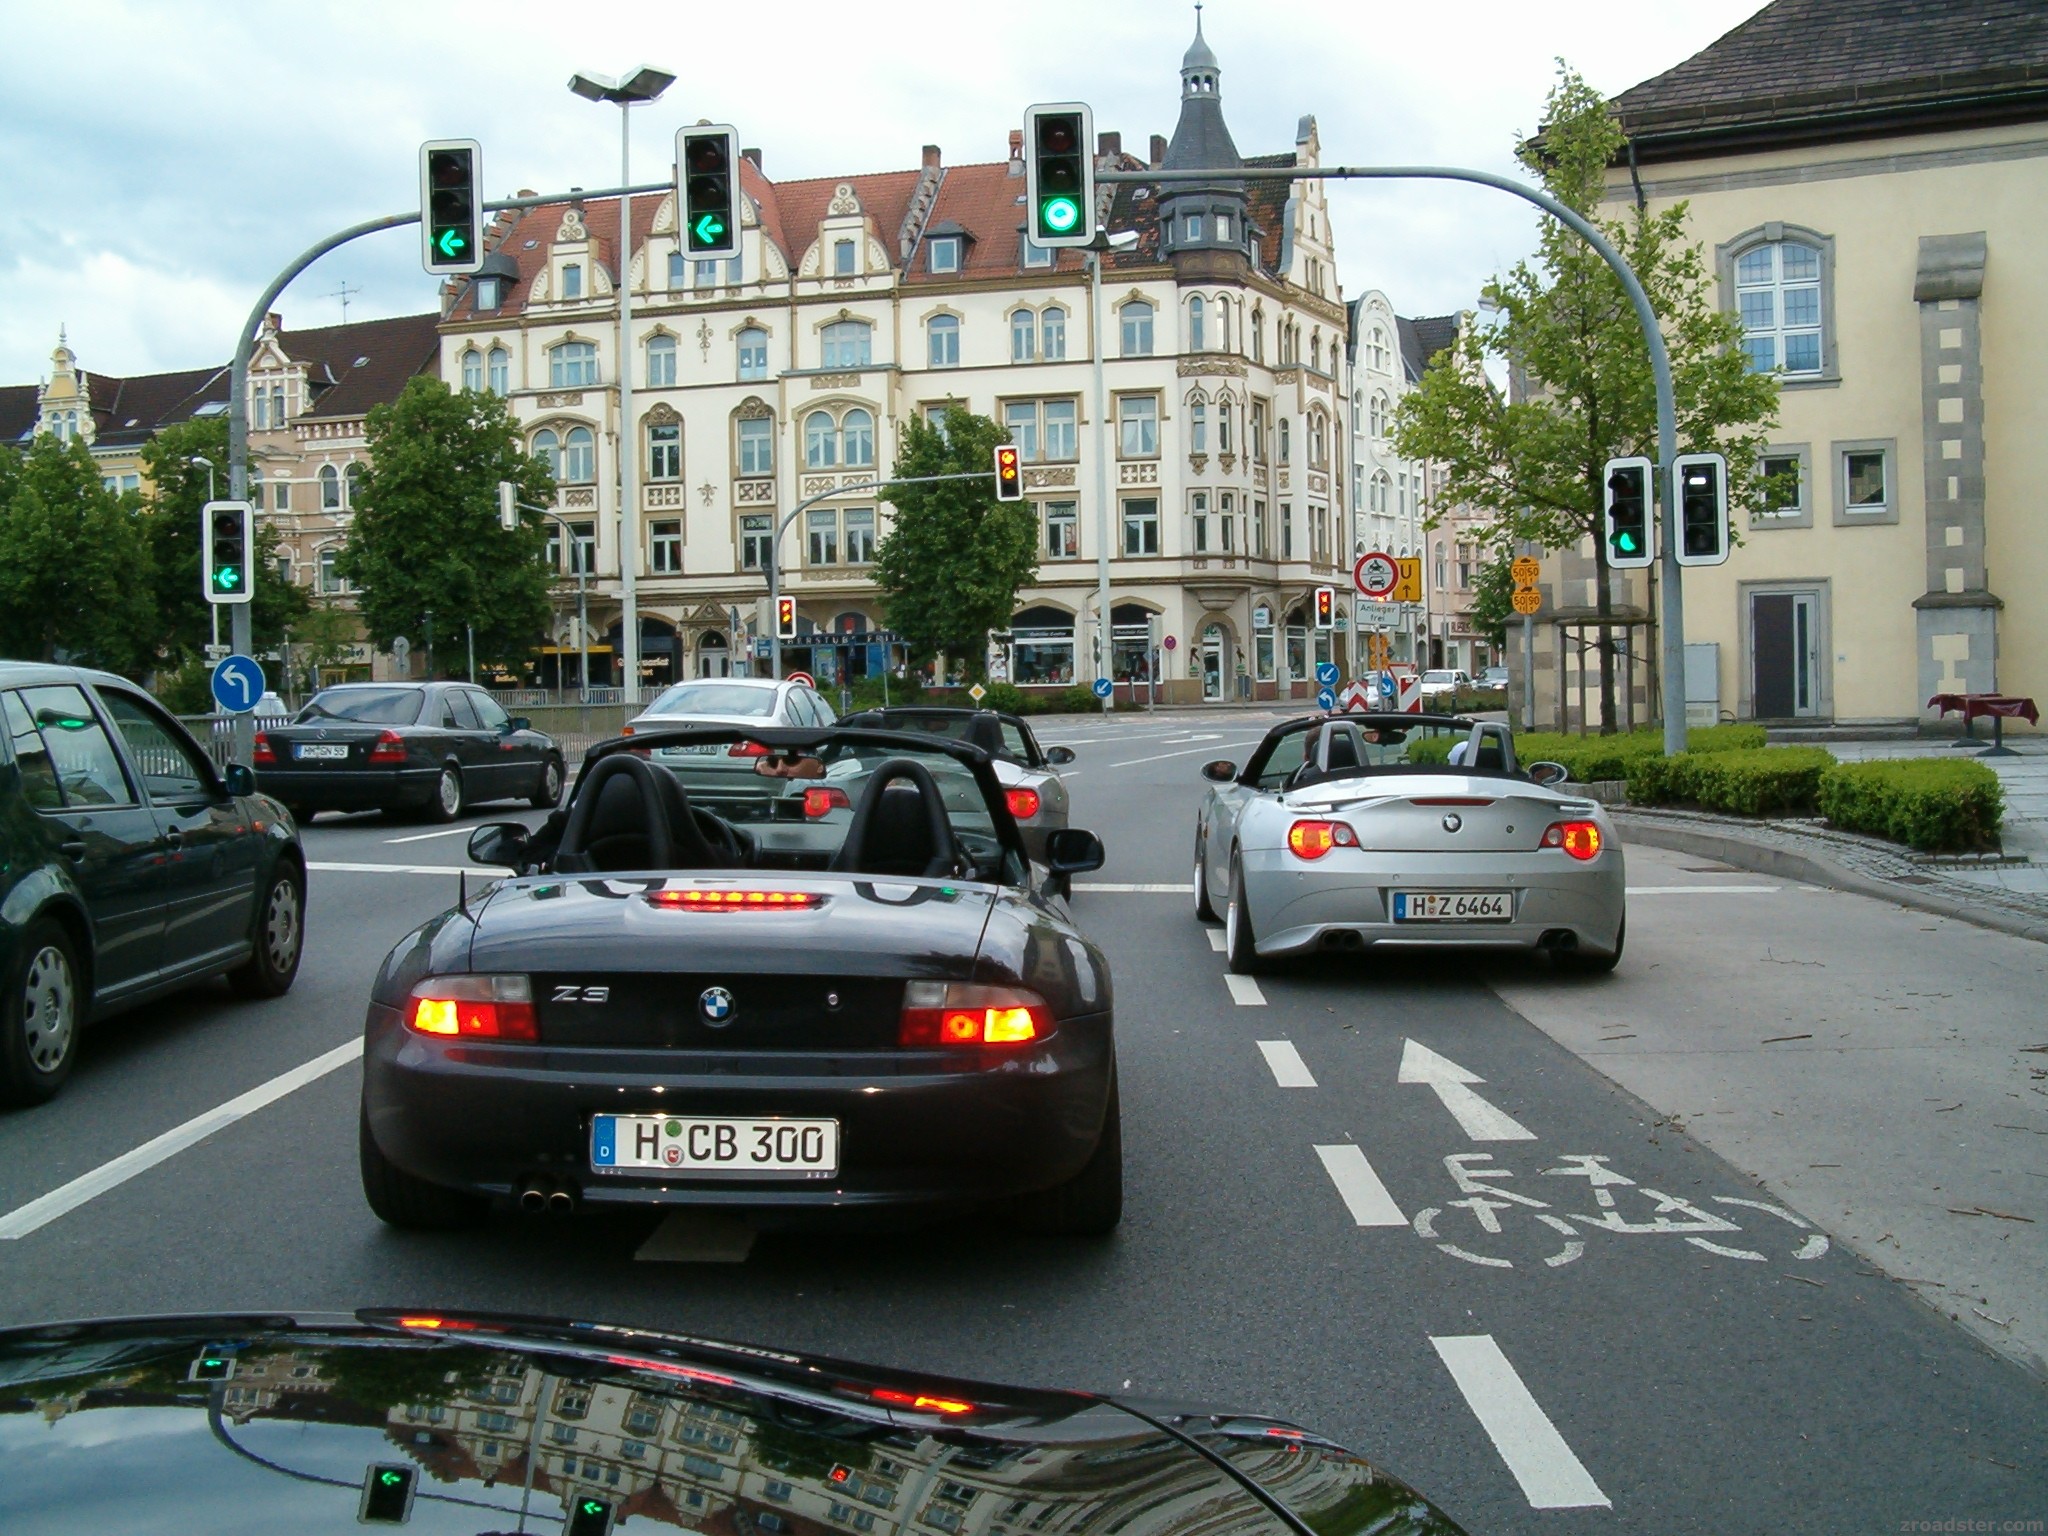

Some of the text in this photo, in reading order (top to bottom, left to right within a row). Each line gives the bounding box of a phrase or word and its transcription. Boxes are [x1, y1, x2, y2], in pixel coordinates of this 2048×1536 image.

[1400, 564, 1412, 579] U
[1513, 567, 1539, 577] 50 50
[1360, 604, 1396, 614] Anlieger
[1413, 896, 1503, 915] H Z 6464
[551, 985, 610, 1003] Z3
[636, 1123, 823, 1163] H CB 300
[600, 1146, 609, 1158] D
